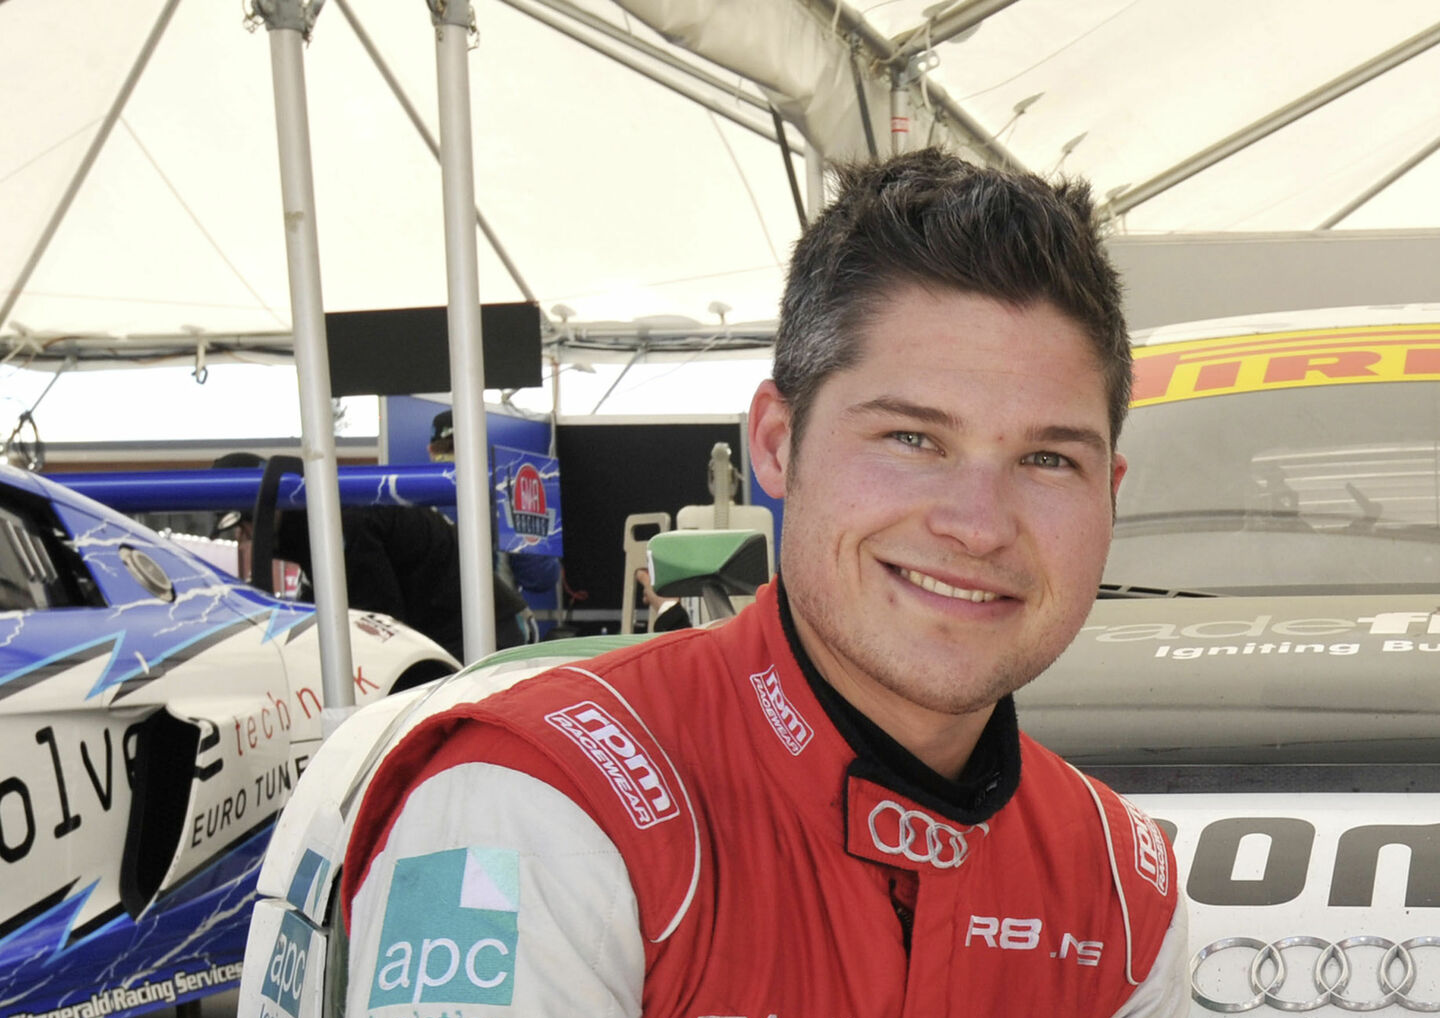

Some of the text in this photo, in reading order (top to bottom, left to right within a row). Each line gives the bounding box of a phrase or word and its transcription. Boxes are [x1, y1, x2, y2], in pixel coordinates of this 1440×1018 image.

[1154, 641, 1360, 660] Igniting
[233, 665, 380, 757] technk
[754, 677, 799, 753] RACEWEAR
[765, 671, 807, 741] rpm
[551, 716, 650, 823] RACEWEAR
[575, 709, 671, 811] rpm
[191, 788, 247, 848] EURO
[965, 914, 1042, 950] R8
[112, 977, 176, 1008] Racing
[174, 961, 244, 994] Services
[270, 931, 306, 1005] apc
[378, 938, 509, 1004] apc
